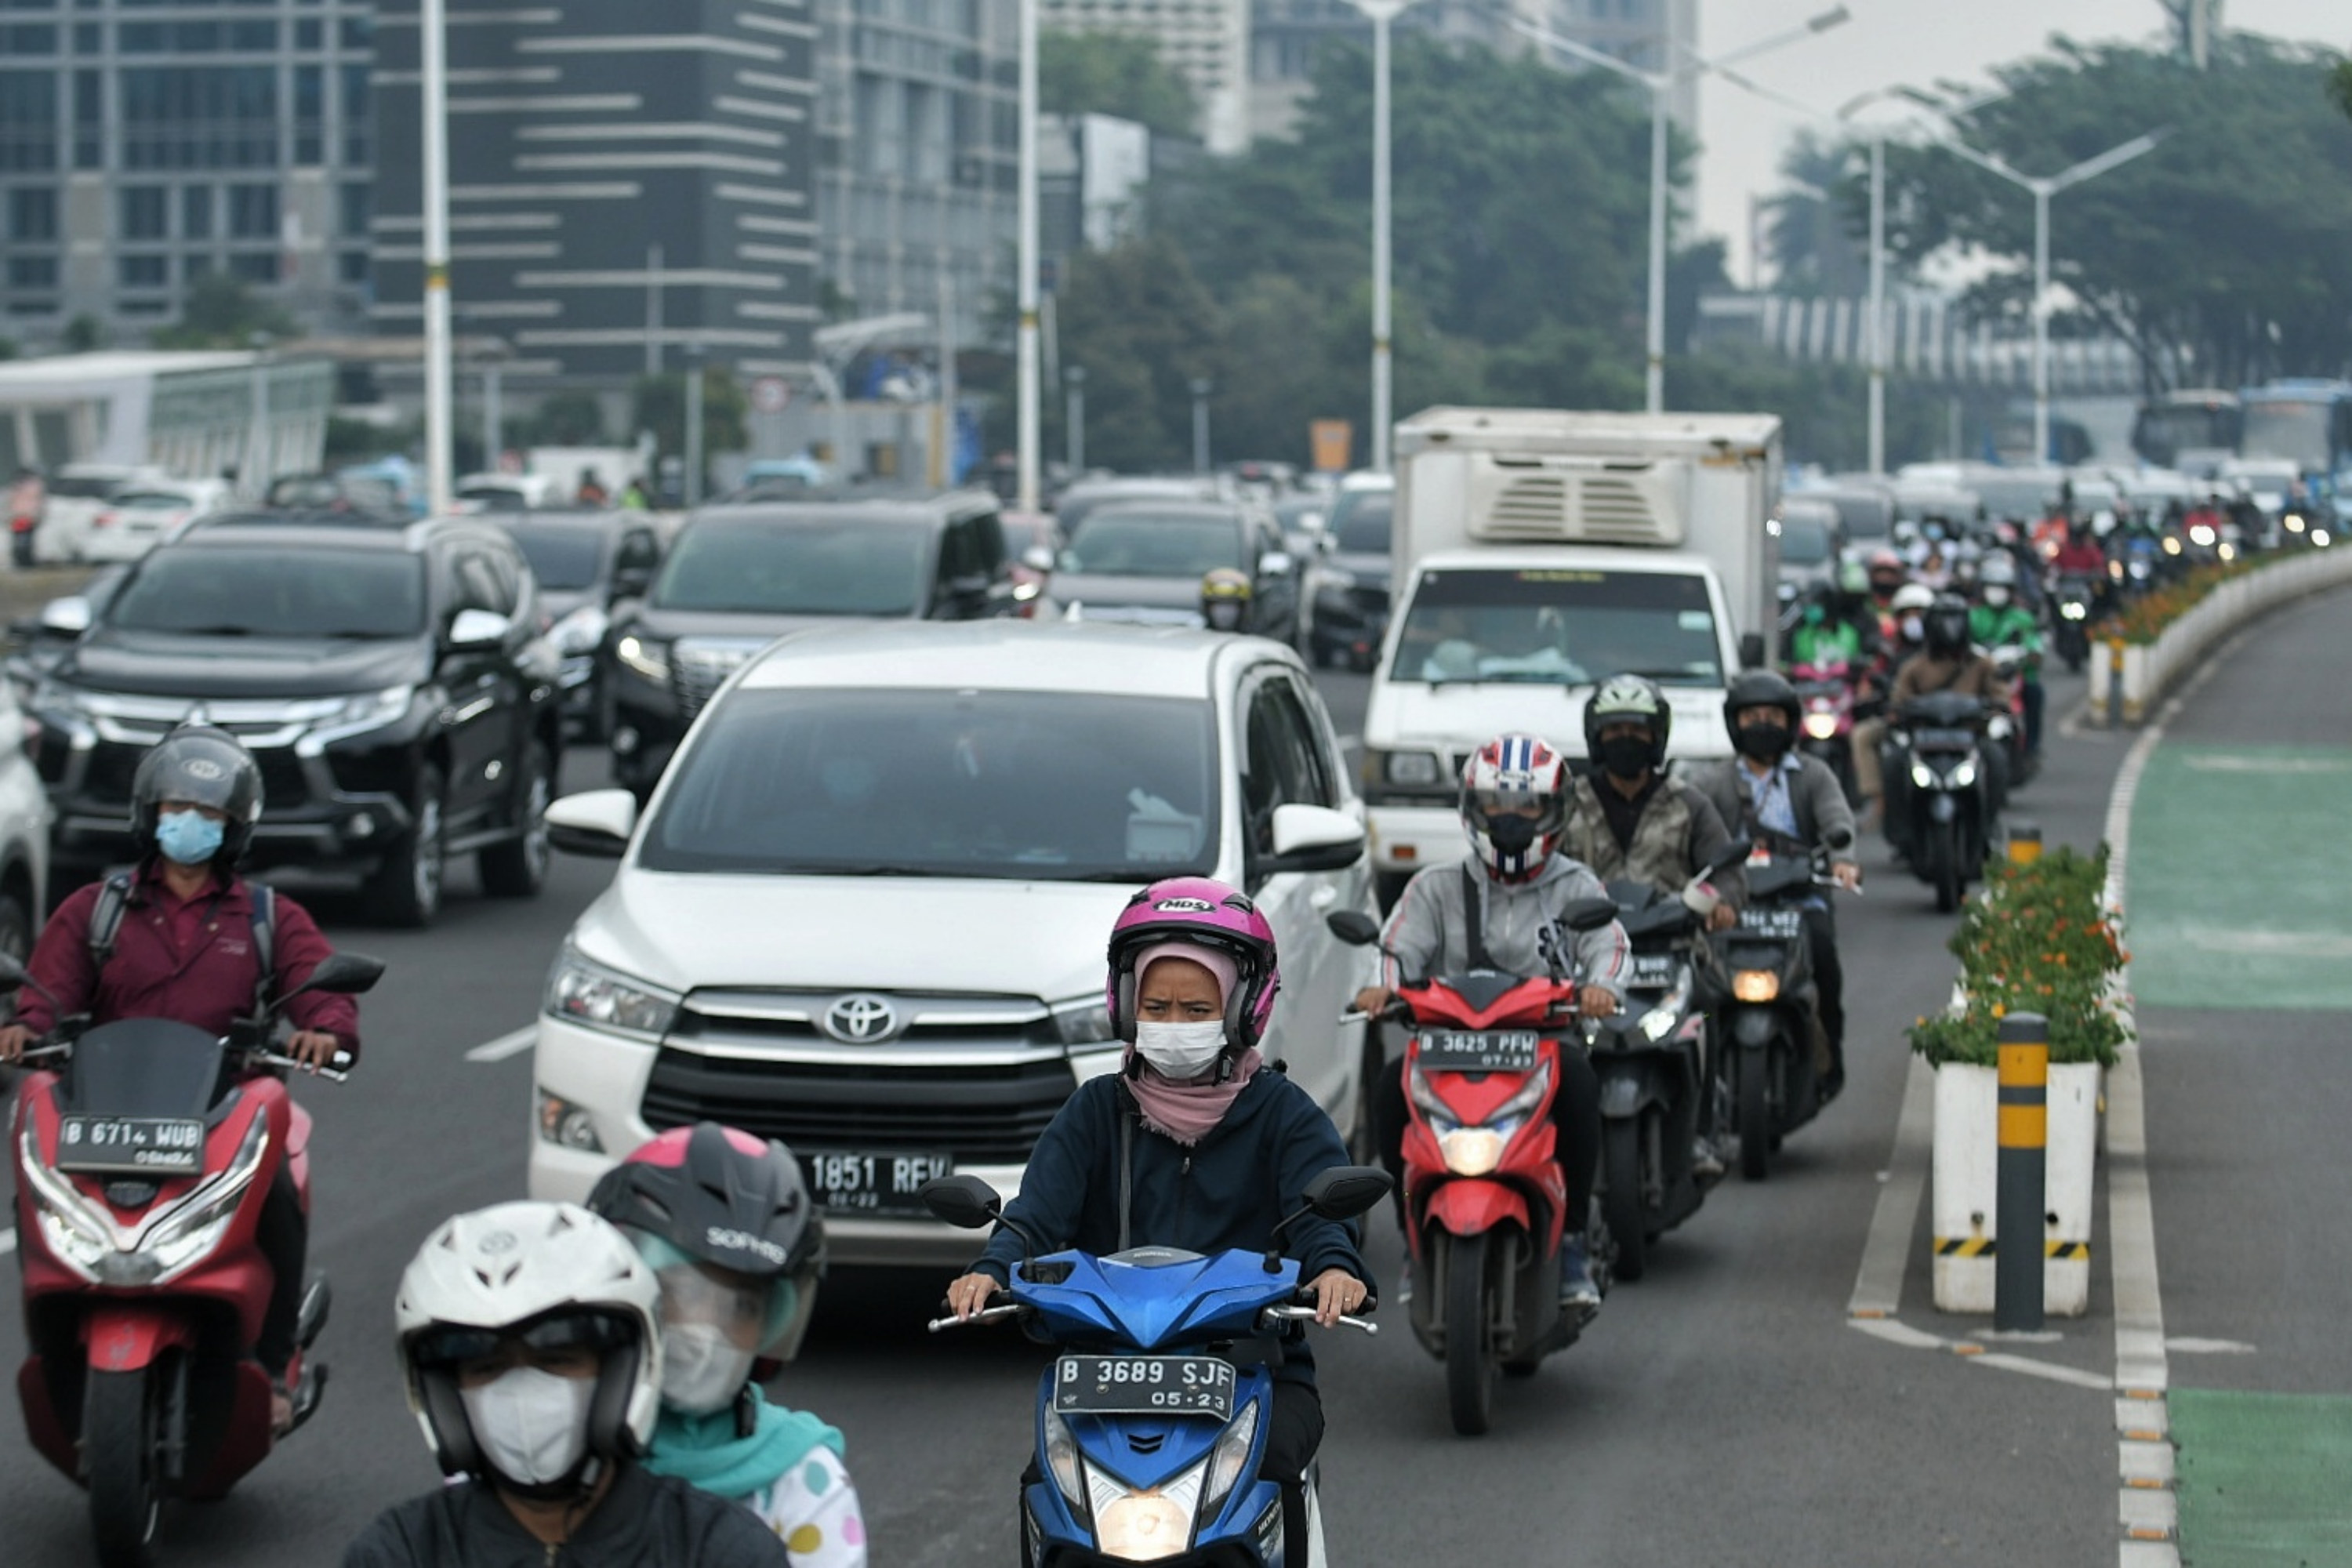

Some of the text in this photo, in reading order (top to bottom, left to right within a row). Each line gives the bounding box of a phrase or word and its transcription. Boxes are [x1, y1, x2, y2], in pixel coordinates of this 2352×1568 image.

[1164, 899, 1205, 909] MDS
[1421, 1033, 1433, 1051] B
[1499, 1034, 1534, 1052] PFW
[67, 1122, 82, 1145] B
[812, 1155, 875, 1190] 1851
[1062, 1360, 1232, 1387] B 3689 SJF
